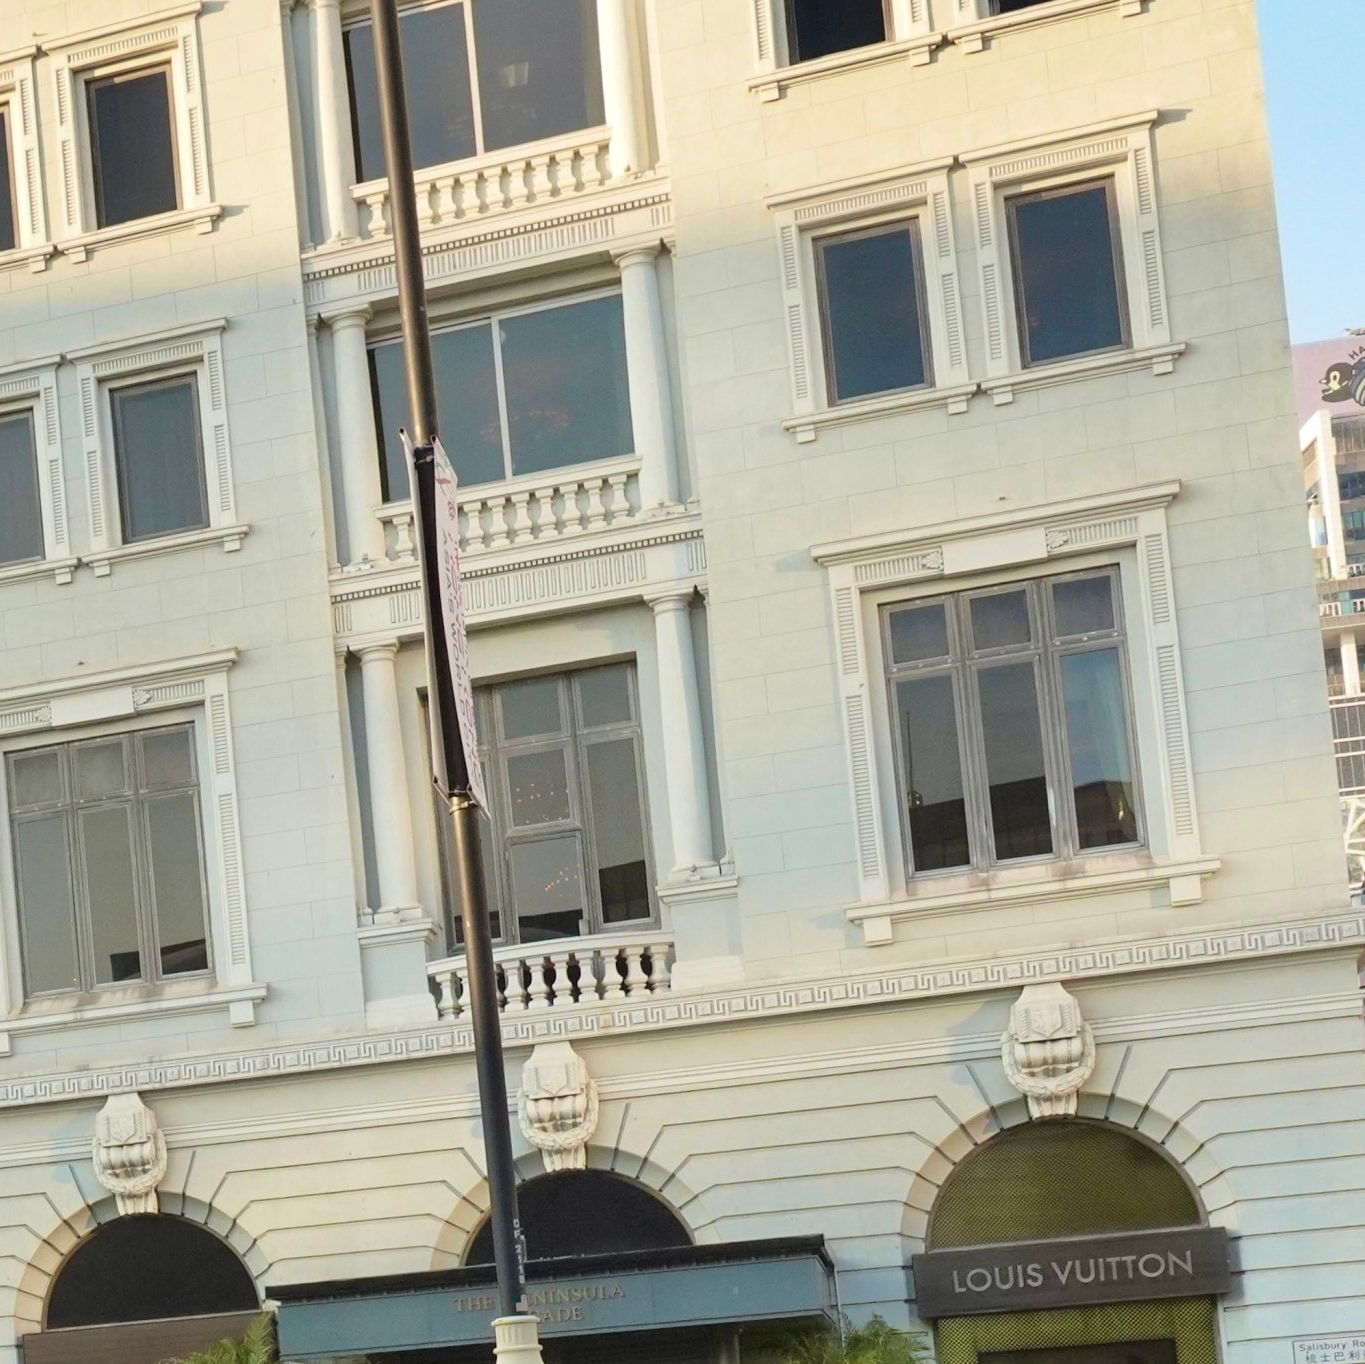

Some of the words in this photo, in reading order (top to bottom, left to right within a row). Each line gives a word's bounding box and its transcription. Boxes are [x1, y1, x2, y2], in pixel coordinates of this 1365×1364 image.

[952, 1261, 1044, 1295] LOUIS
[1050, 1249, 1194, 1287] VUITTON
[454, 1295, 494, 1312] THE
[529, 1284, 626, 1307] NINSULA
[529, 1306, 583, 1324] CADE
[1299, 1342, 1346, 1352] Salisbury
[1306, 1350, 1365, 1364] 梳士巴利
